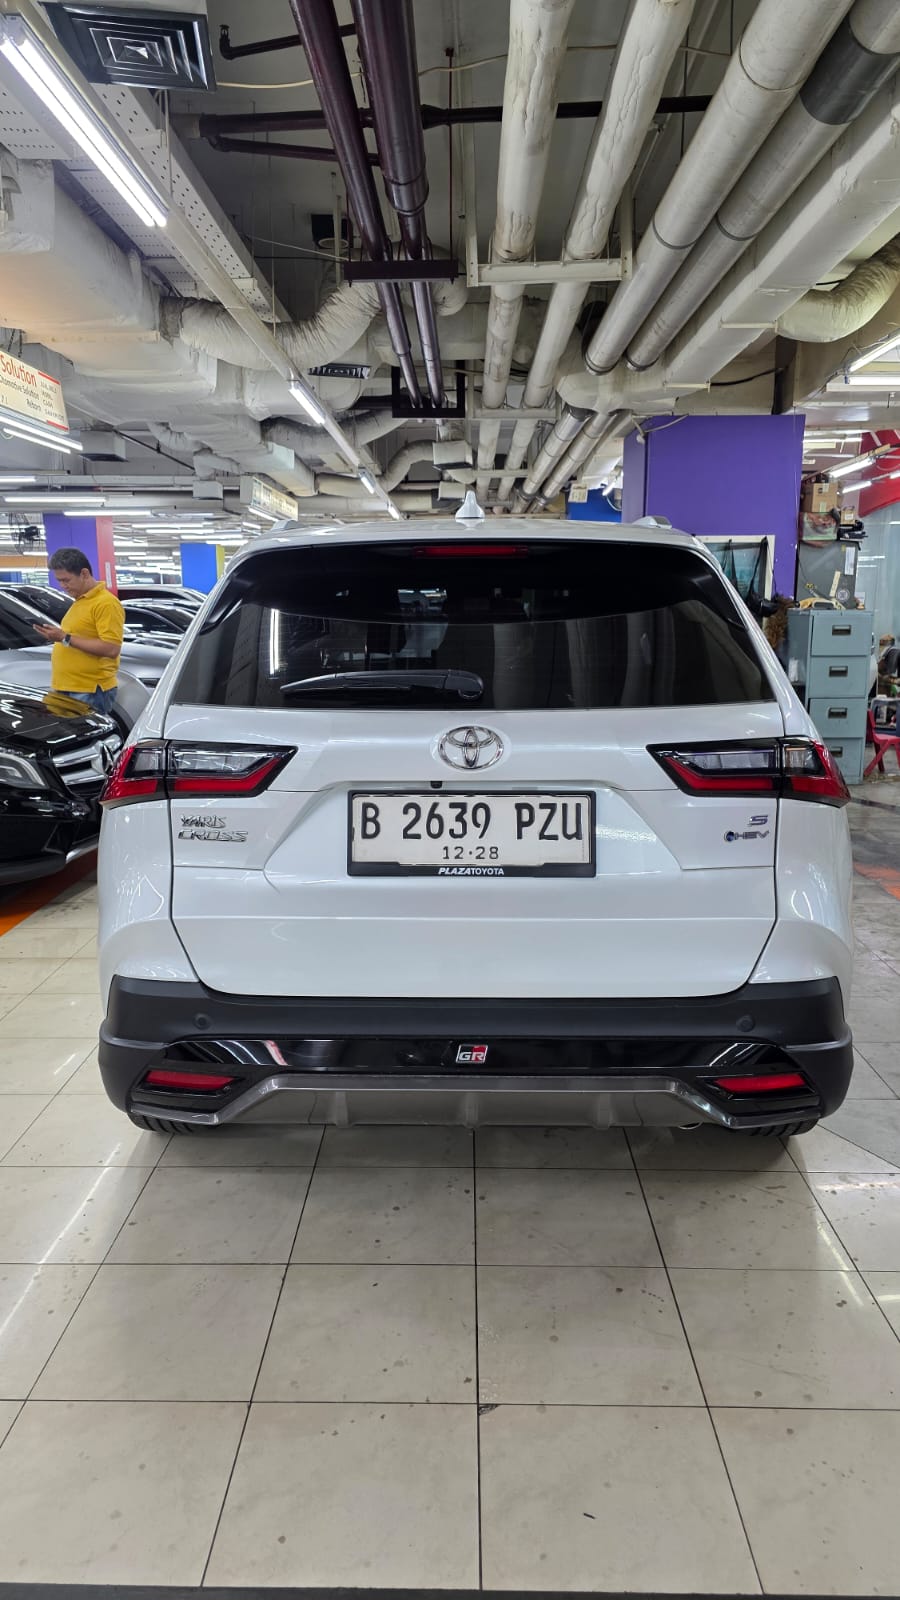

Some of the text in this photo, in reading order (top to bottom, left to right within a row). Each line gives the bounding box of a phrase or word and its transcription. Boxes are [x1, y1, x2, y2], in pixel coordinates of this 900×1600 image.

[0, 354, 37, 388] Solution
[180, 814, 227, 828] YARIS
[361, 802, 583, 841] B 2639 PZU
[747, 814, 769, 826] S
[178, 829, 248, 842] CROSS
[459, 1051, 485, 1061] GR
